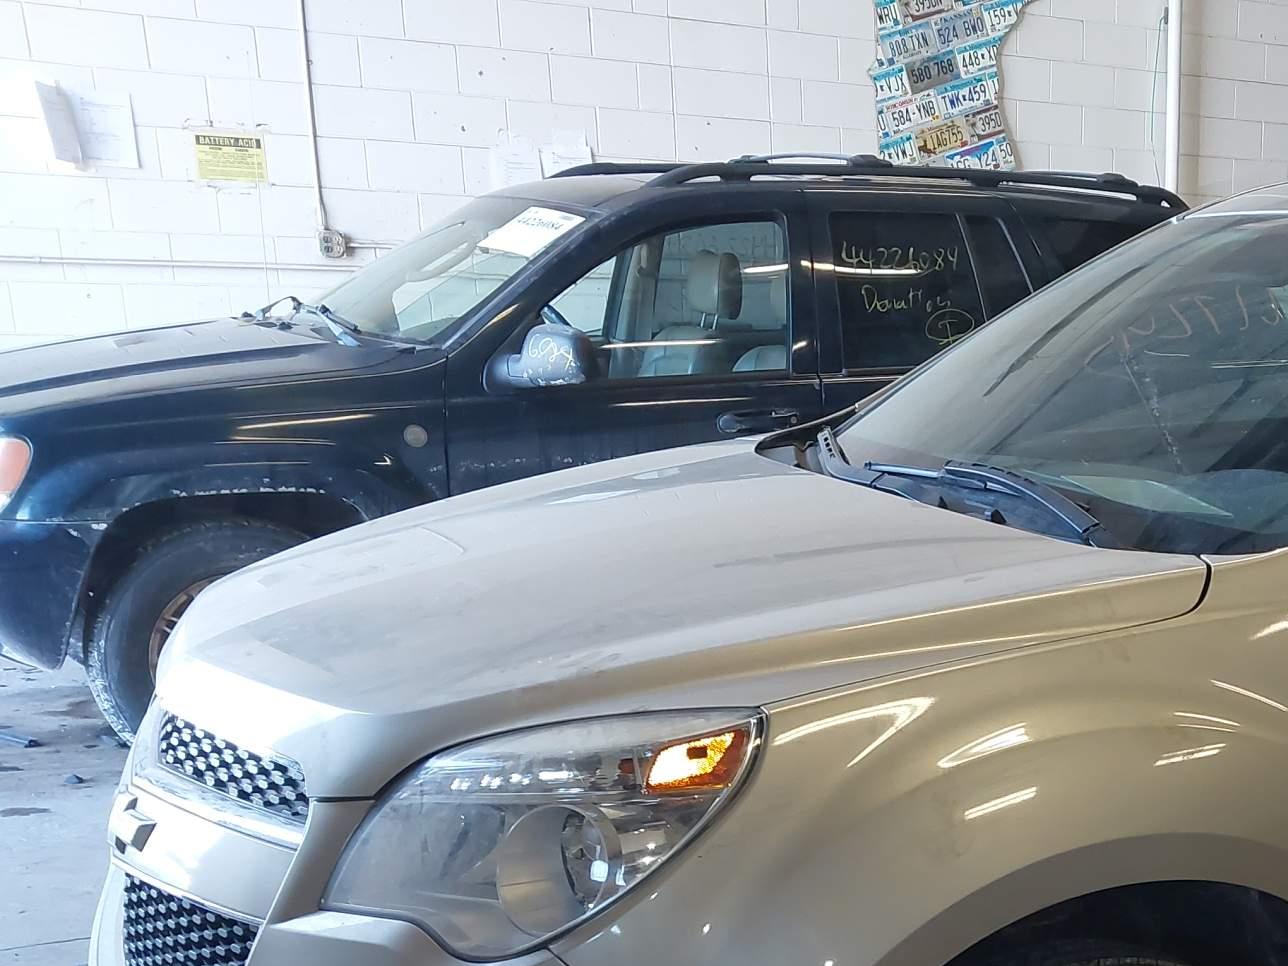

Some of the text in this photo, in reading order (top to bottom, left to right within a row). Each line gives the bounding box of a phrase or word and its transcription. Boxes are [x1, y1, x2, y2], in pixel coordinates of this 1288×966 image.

[937, 24, 959, 45] 524
[962, 50, 981, 69] 448
[967, 83, 987, 104] 459
[199, 136, 257, 149] BATTERY ACID
[841, 241, 958, 271] 44226084
